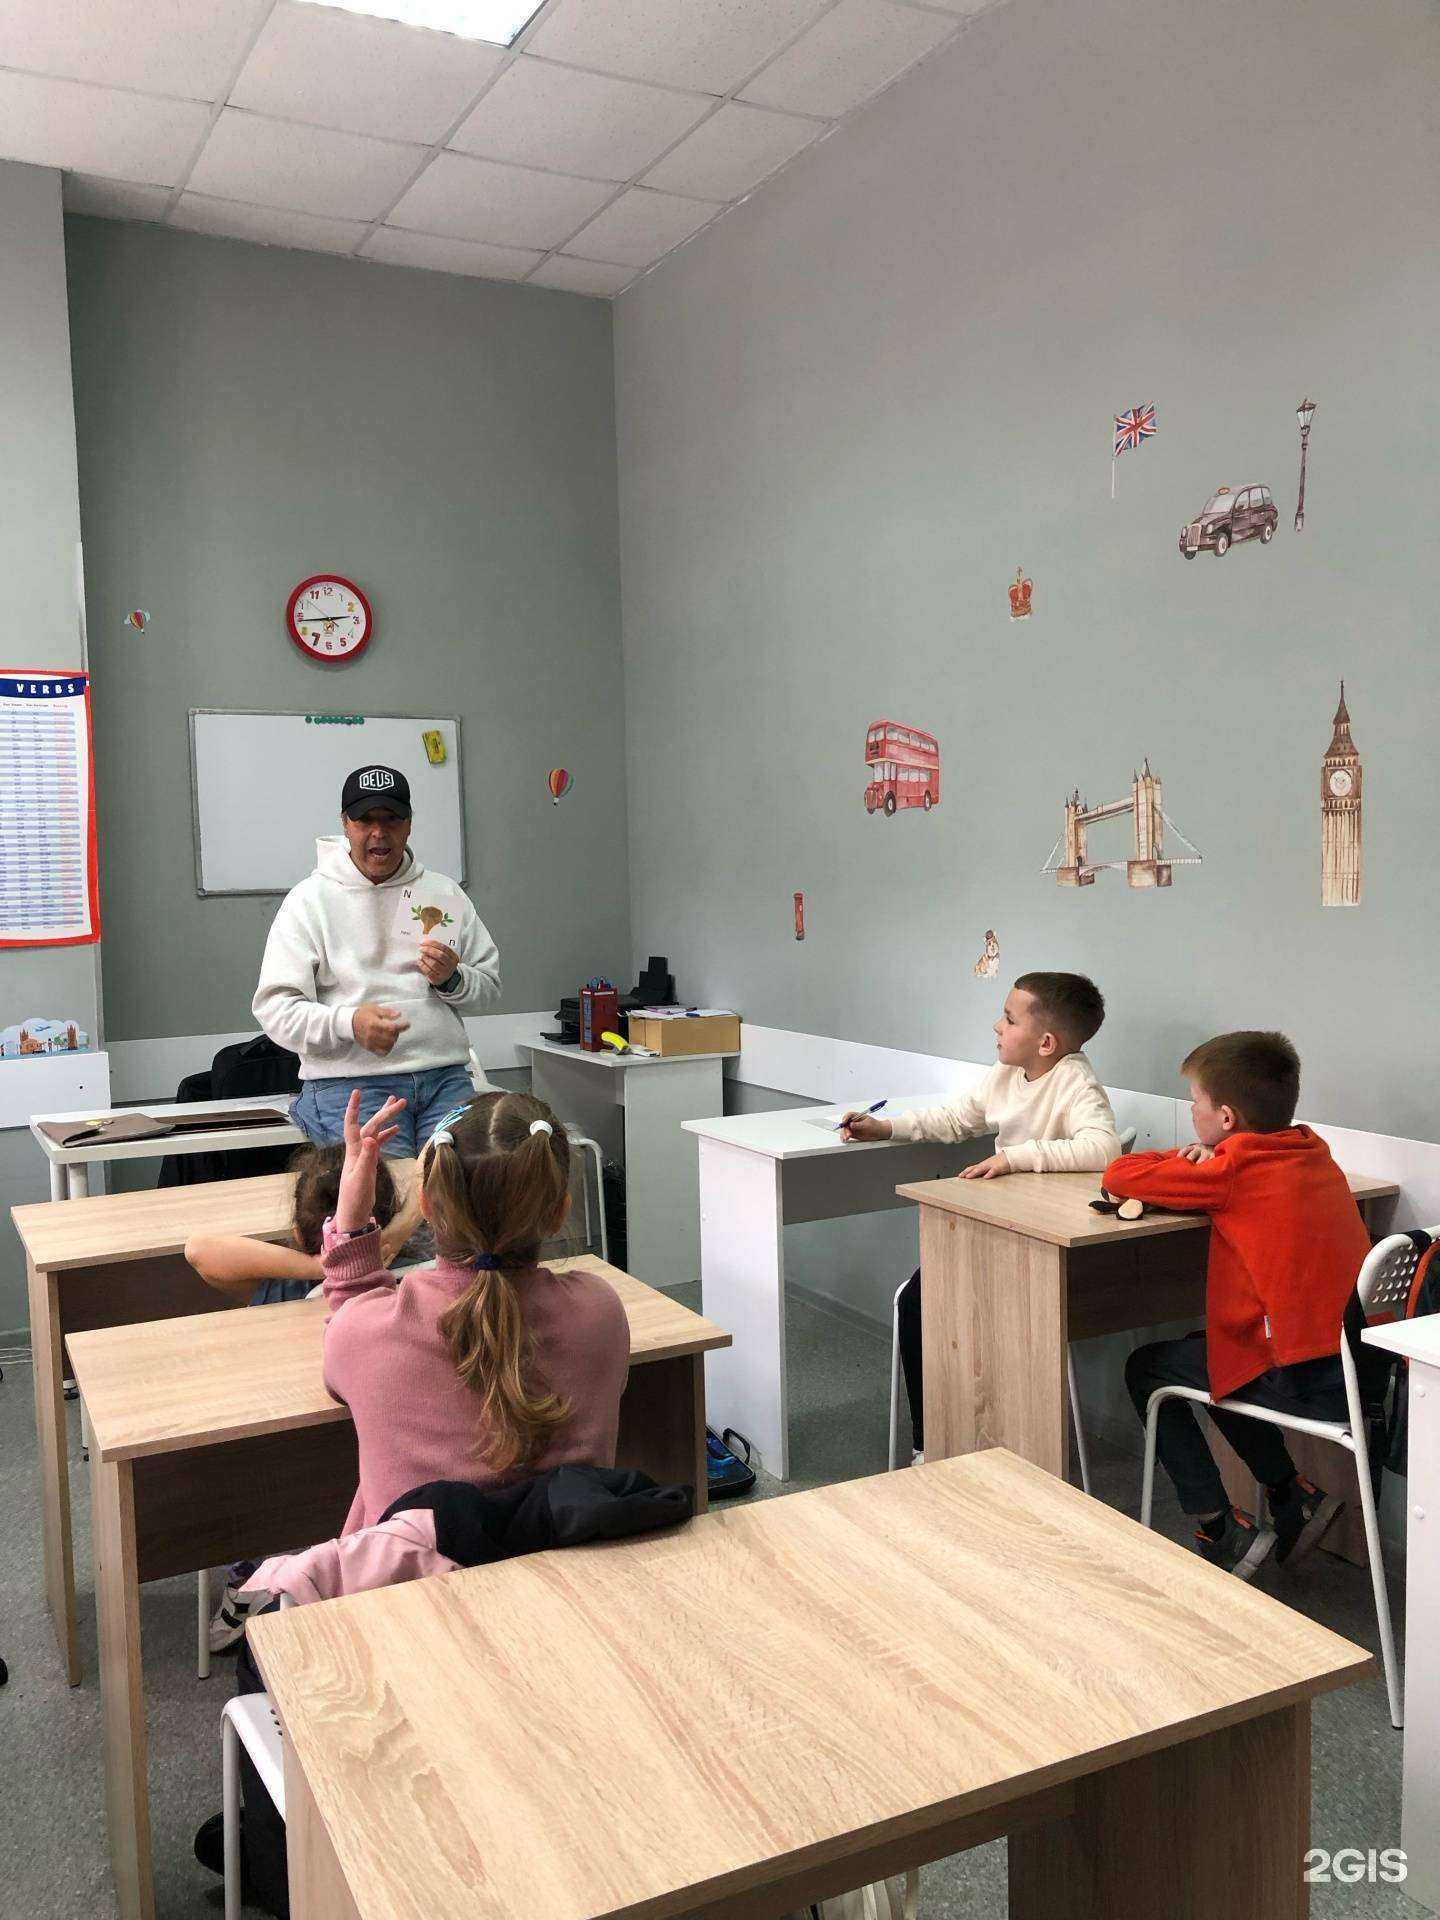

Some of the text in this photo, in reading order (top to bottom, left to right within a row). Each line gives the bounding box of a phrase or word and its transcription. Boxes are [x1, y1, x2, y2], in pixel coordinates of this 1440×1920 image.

[309, 590, 320, 600] 11
[323, 587, 334, 597] 12
[347, 601, 354, 613] 2
[352, 615, 360, 625] 3
[312, 632, 321, 647] 7
[340, 637, 347, 647] 5
[325, 641, 333, 650] 6
[16, 683, 75, 694] VERBS
[362, 771, 392, 788] DEUS
[403, 889, 411, 899] N
[448, 938, 456, 947] n
